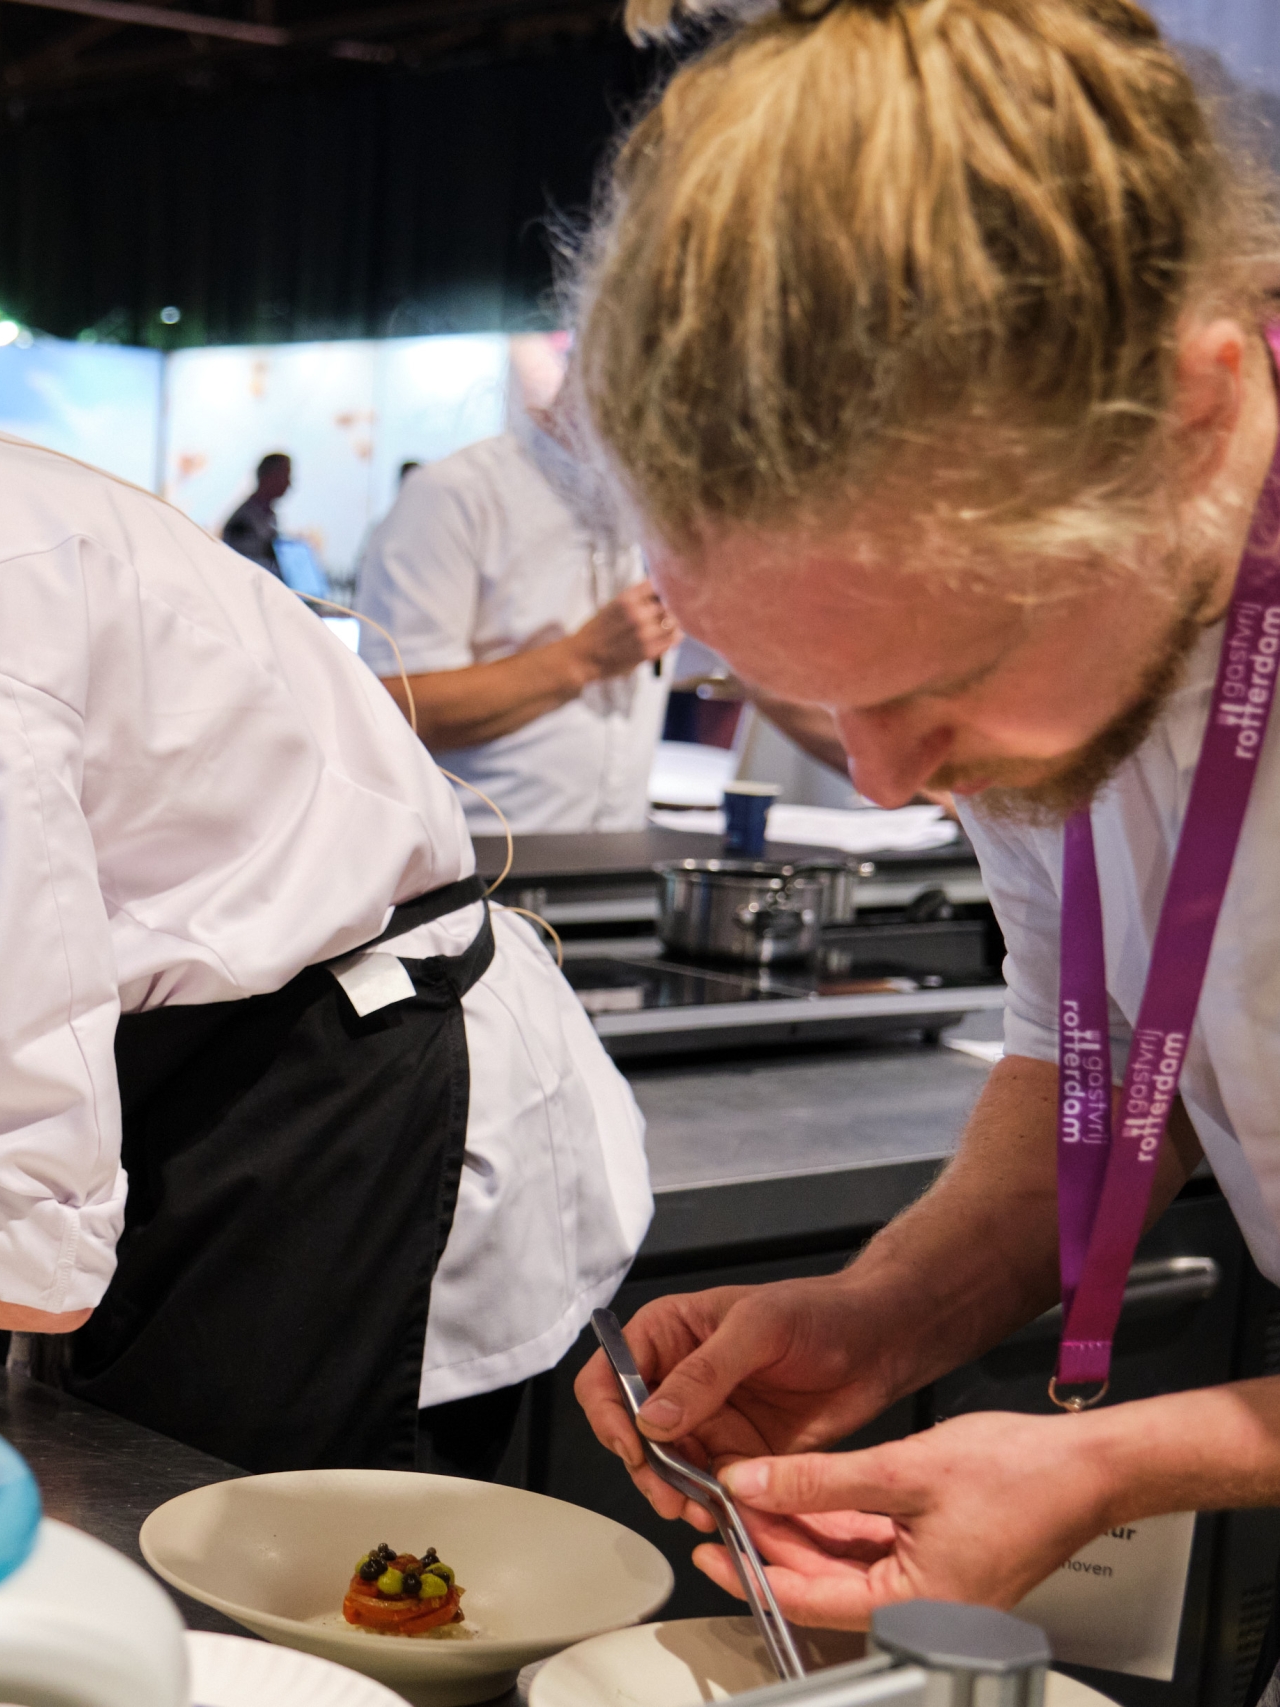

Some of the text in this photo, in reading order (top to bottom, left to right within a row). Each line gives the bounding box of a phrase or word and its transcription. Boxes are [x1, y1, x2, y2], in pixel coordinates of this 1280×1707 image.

[1221, 601, 1262, 698] gastvrij
[1232, 605, 1280, 759] rotterdam
[1062, 999, 1090, 1144] rotterdam
[1082, 1055, 1108, 1145] gastvrij
[1126, 1029, 1164, 1114] gastvrij
[1135, 1032, 1185, 1162] rotterdam
